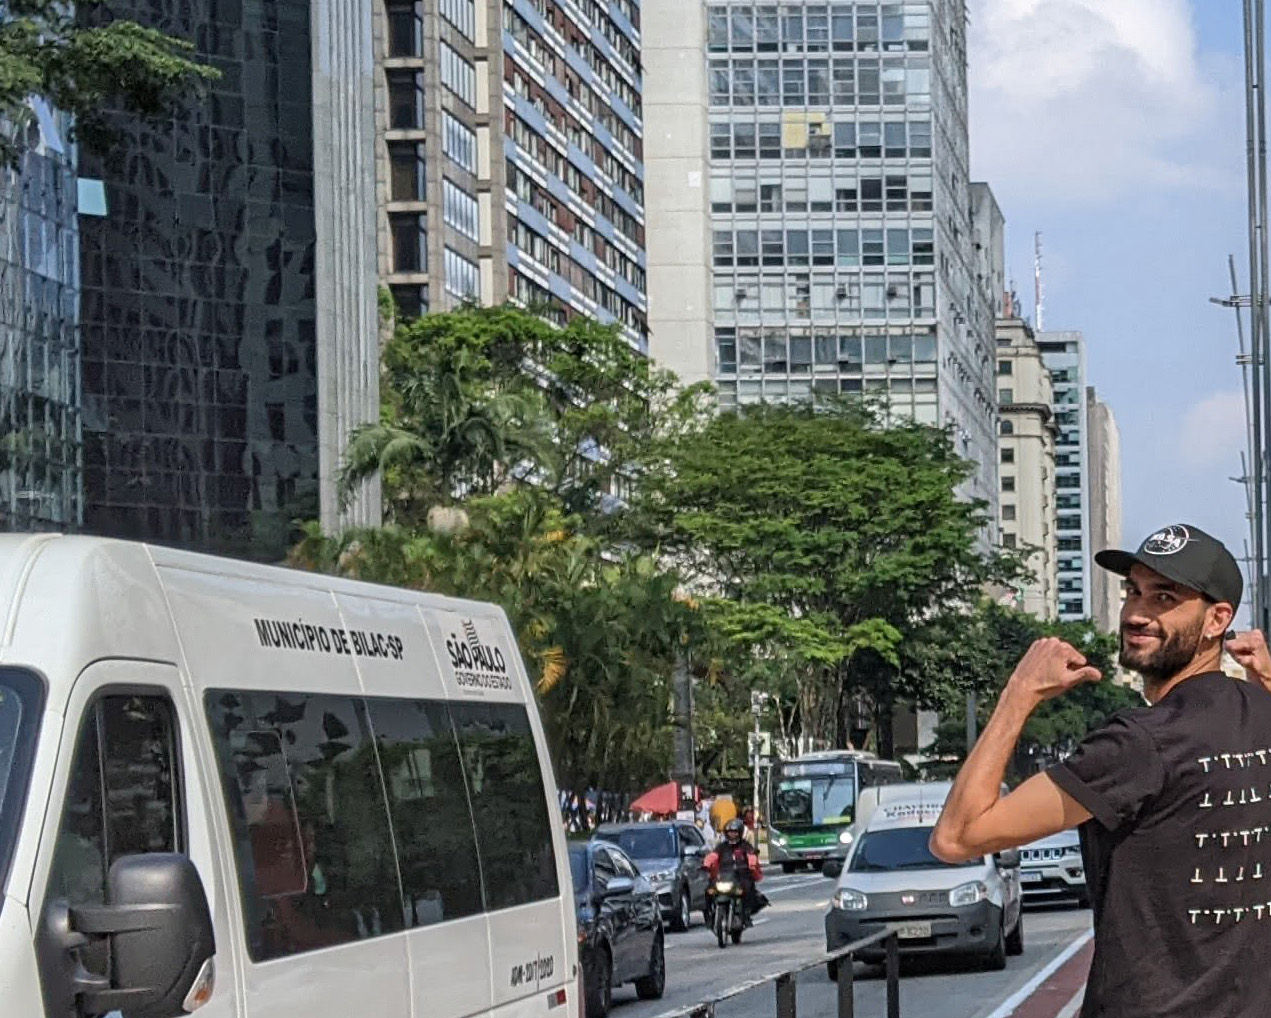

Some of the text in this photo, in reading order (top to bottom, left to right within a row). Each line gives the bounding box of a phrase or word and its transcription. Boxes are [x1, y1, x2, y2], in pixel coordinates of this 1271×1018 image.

[254, 618, 403, 660] MUNICÍPIO DE BILAC-SP
[446, 632, 506, 674] SÃO PAULO
